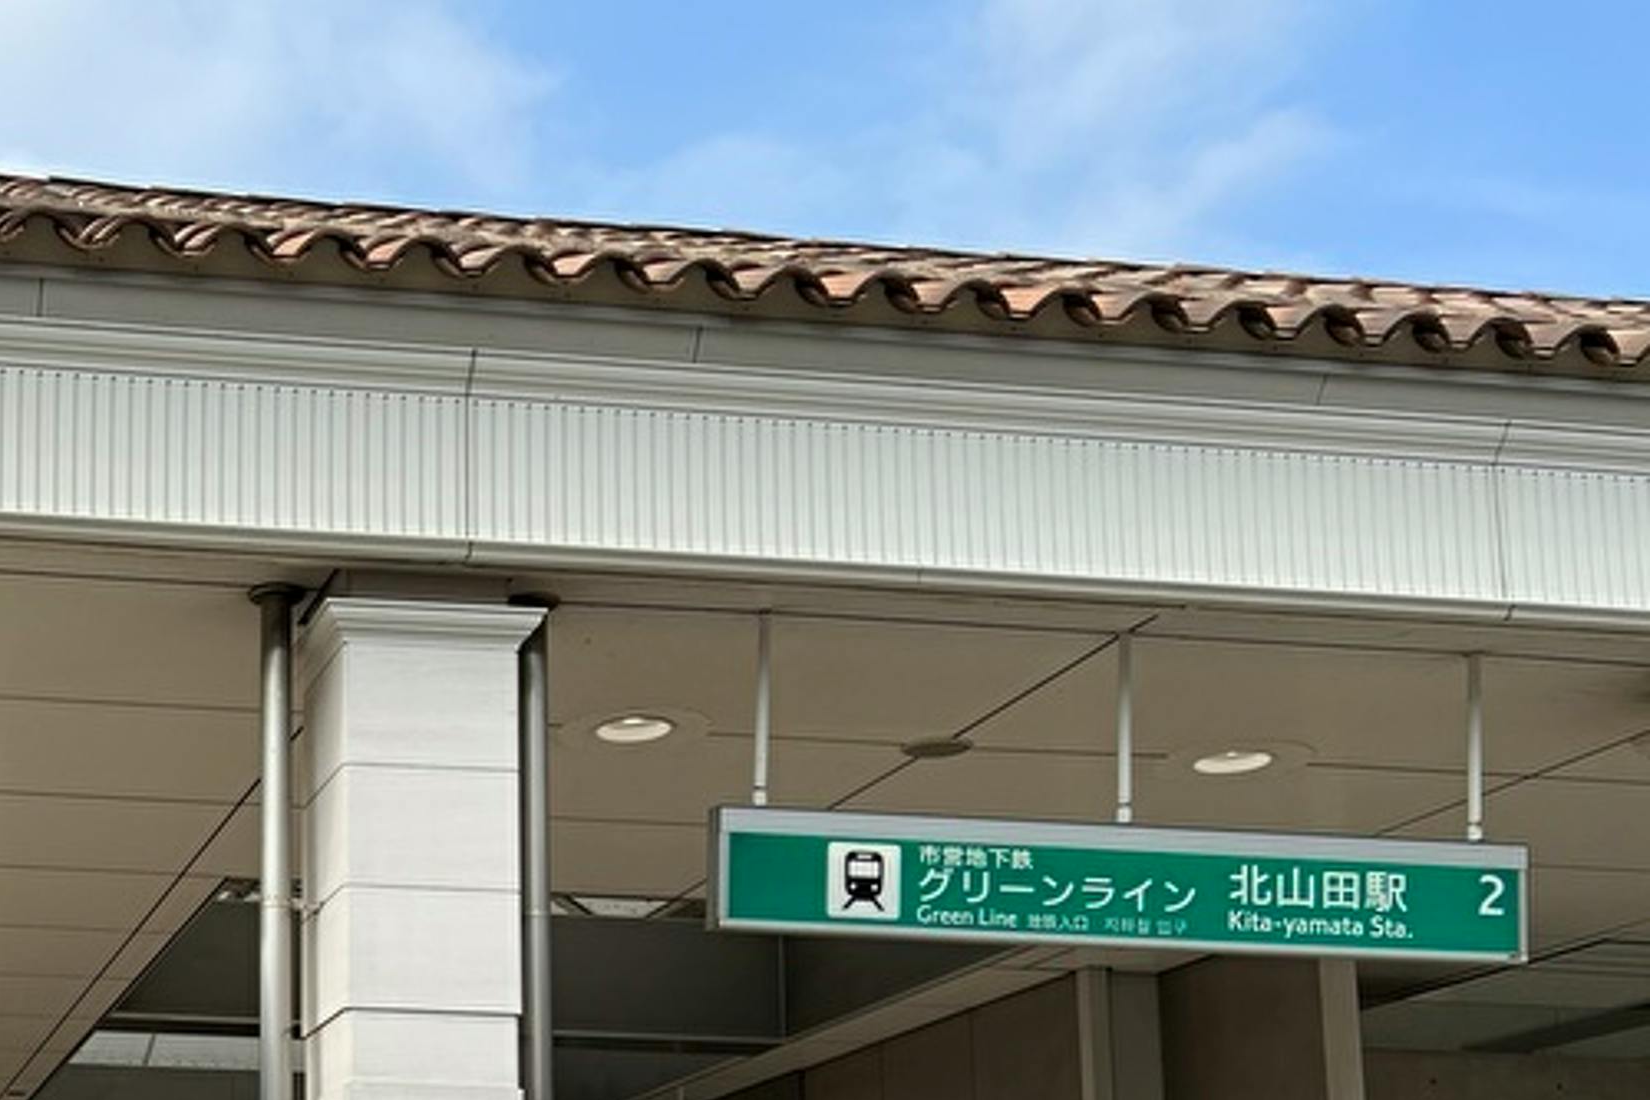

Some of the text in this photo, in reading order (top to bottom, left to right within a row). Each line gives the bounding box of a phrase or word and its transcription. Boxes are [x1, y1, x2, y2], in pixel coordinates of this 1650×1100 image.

[919, 844, 1034, 870] 市営地下鉄
[918, 867, 1196, 913] グリーンライン
[1229, 864, 1408, 912] 北山田駅
[1477, 874, 1505, 916] 2
[916, 904, 1018, 928] Green Line
[1227, 910, 1414, 939] Kita-yamata Sta.
